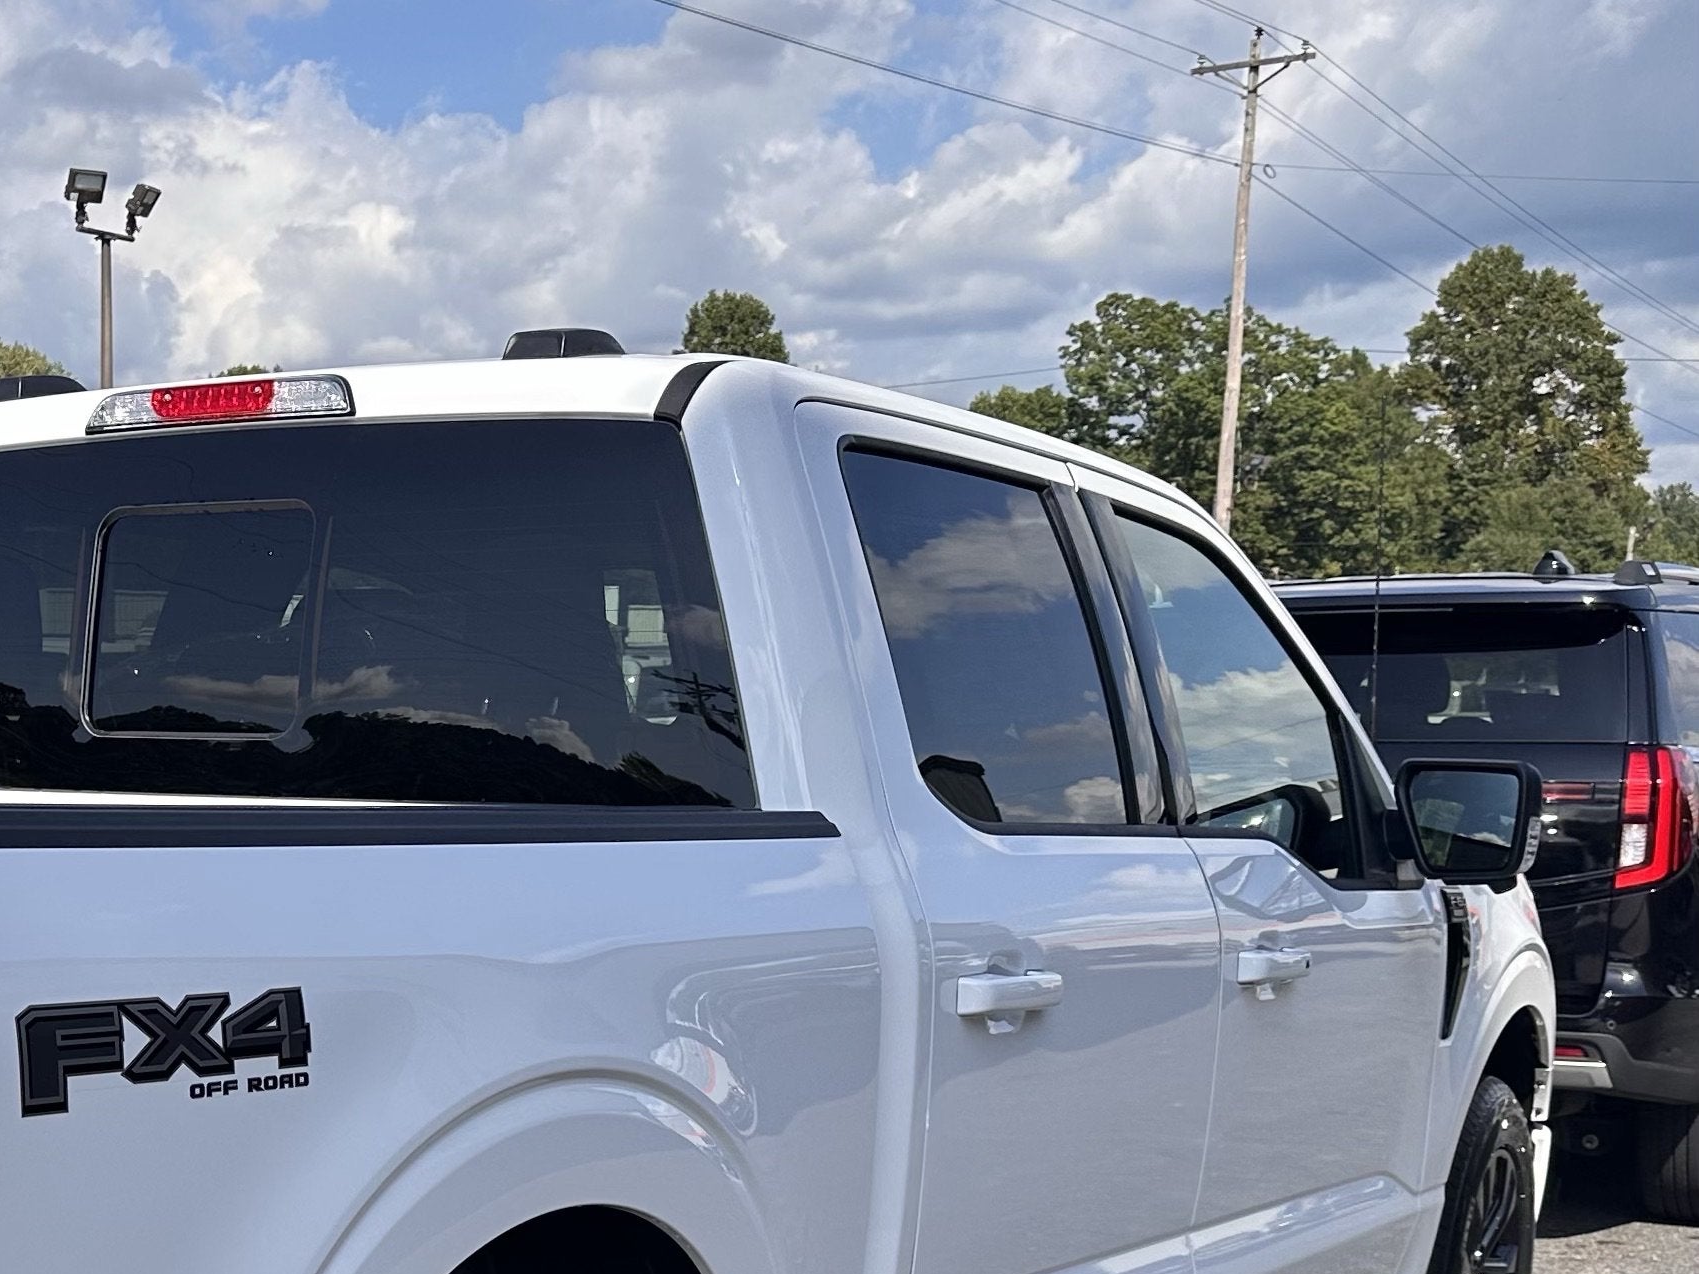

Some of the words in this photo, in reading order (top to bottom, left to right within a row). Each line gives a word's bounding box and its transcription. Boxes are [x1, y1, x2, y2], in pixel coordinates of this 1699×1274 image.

[14, 986, 312, 1118] FX4
[189, 1079, 239, 1100] OFF
[247, 1071, 310, 1093] ROAD
